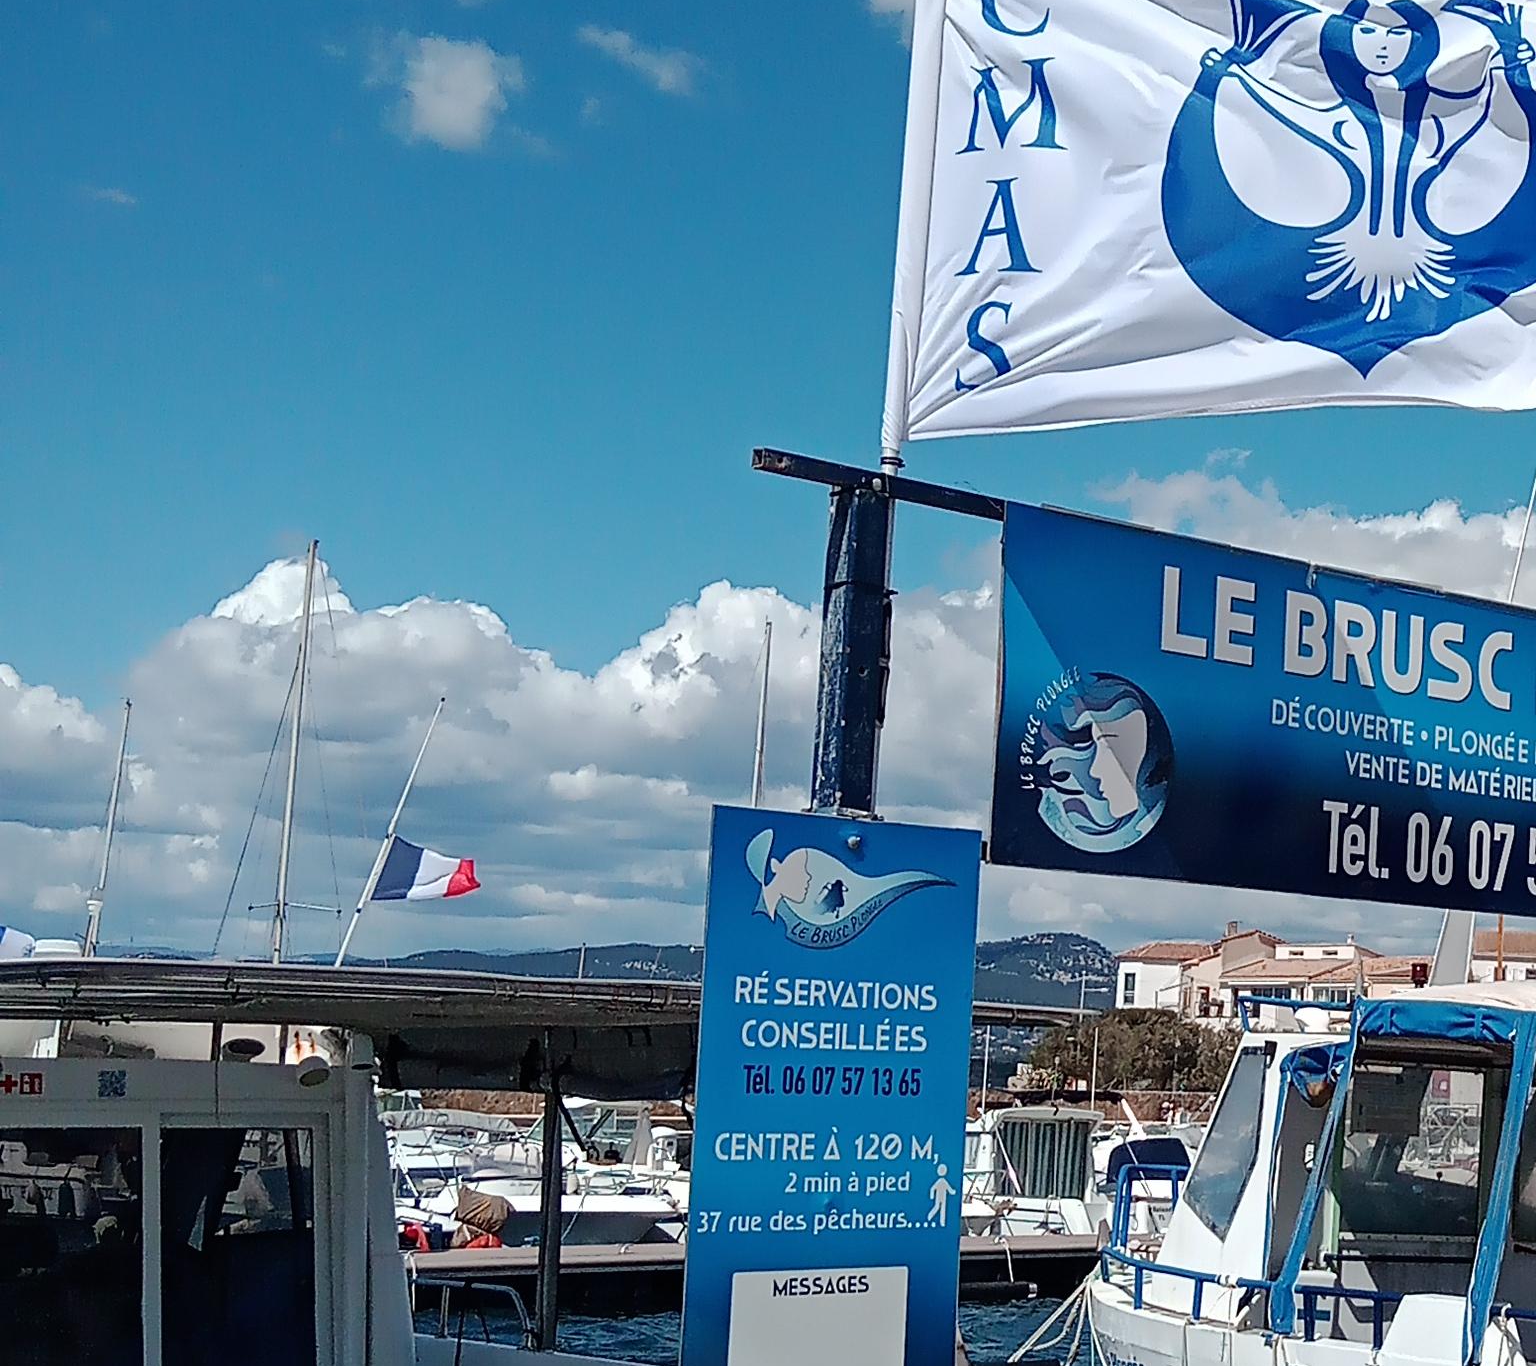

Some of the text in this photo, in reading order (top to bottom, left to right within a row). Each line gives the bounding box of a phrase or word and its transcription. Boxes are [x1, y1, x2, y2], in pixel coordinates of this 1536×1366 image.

[1160, 565, 1257, 666] LE
[1284, 588, 1513, 712] BRUSC
[1434, 725, 1530, 764] PLONGÉE
[1345, 750, 1410, 784] VENTE
[1416, 761, 1443, 789] DE
[1322, 799, 1389, 879] Tél.
[1406, 811, 1454, 886] 06
[1468, 820, 1515, 892] 07
[734, 970, 938, 1011] RÉSERVATIONS
[741, 1018, 928, 1052] CONSEILLÉES
[743, 1064, 922, 1097] Tél. 06 07 57 13 65
[714, 1126, 940, 1164] CENTRE À 120 M,
[784, 1171, 911, 1196] 2 min à pied
[696, 1211, 722, 1233] 37
[728, 1215, 762, 1233] rue
[769, 1210, 807, 1231] des
[772, 1275, 870, 1297] MESSAGES
